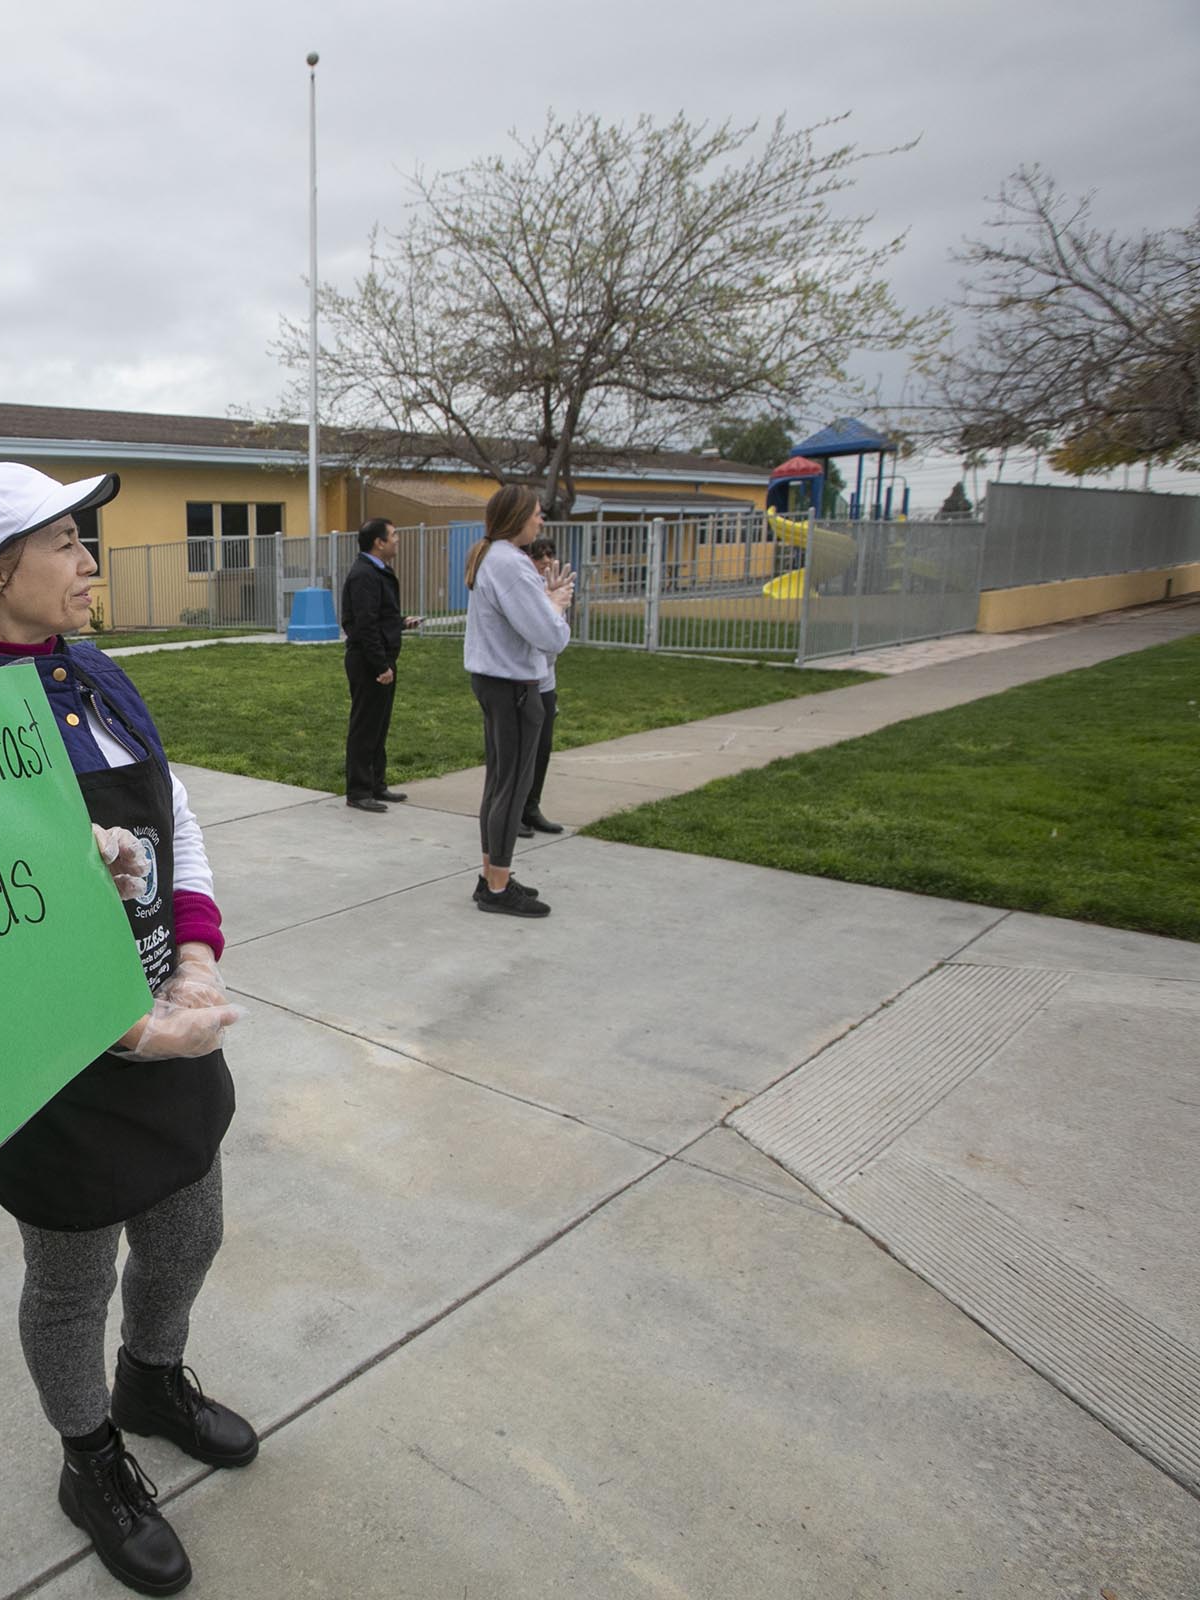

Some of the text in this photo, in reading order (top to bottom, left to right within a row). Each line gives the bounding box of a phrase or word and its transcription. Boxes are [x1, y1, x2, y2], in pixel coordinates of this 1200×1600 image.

[133, 826, 160, 846] Nutrition
[135, 897, 163, 918] Services
[136, 924, 165, 955] ULES
